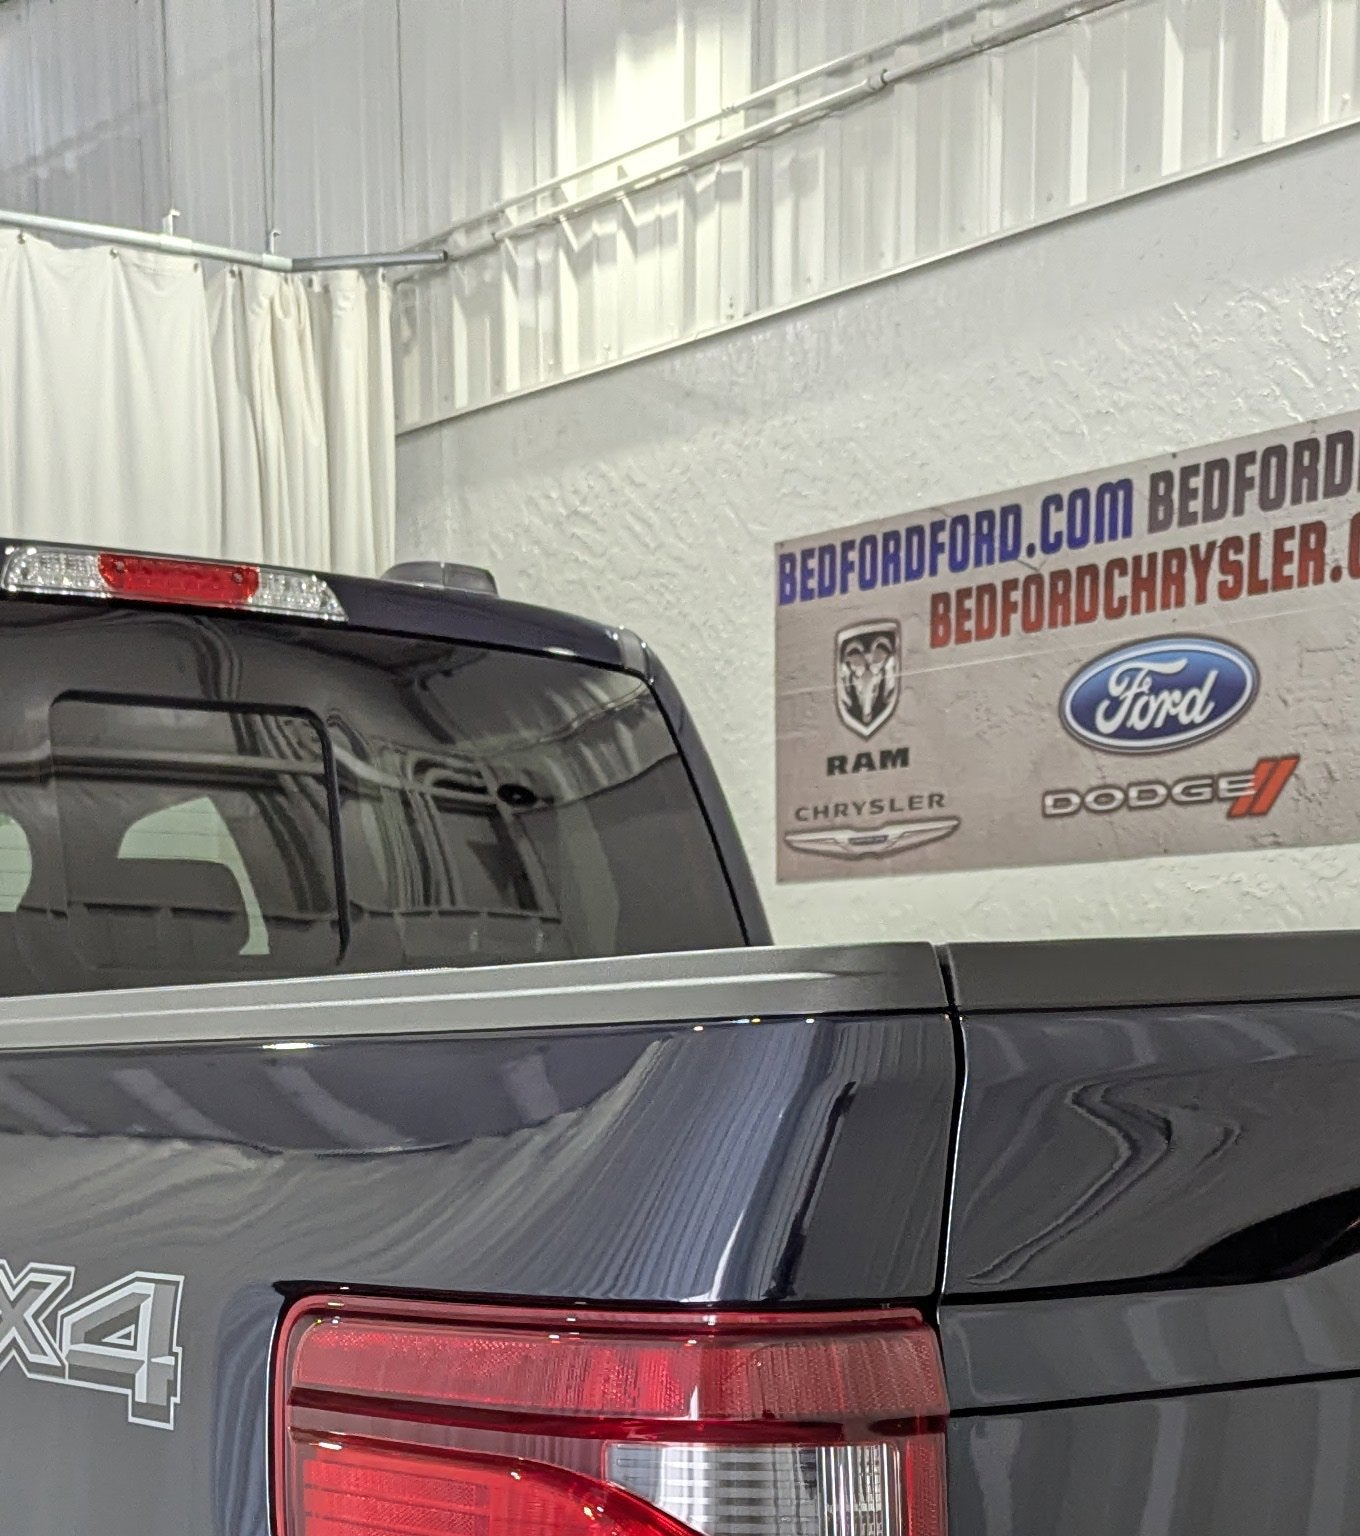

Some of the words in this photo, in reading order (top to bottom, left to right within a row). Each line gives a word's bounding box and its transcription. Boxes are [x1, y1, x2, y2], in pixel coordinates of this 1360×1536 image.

[777, 477, 1134, 606] BEDFORDFORD.COM
[1095, 657, 1219, 734] Ford
[826, 747, 910, 776] RAM
[794, 793, 946, 822] CHRYSLER
[1042, 770, 1258, 818] DODGE
